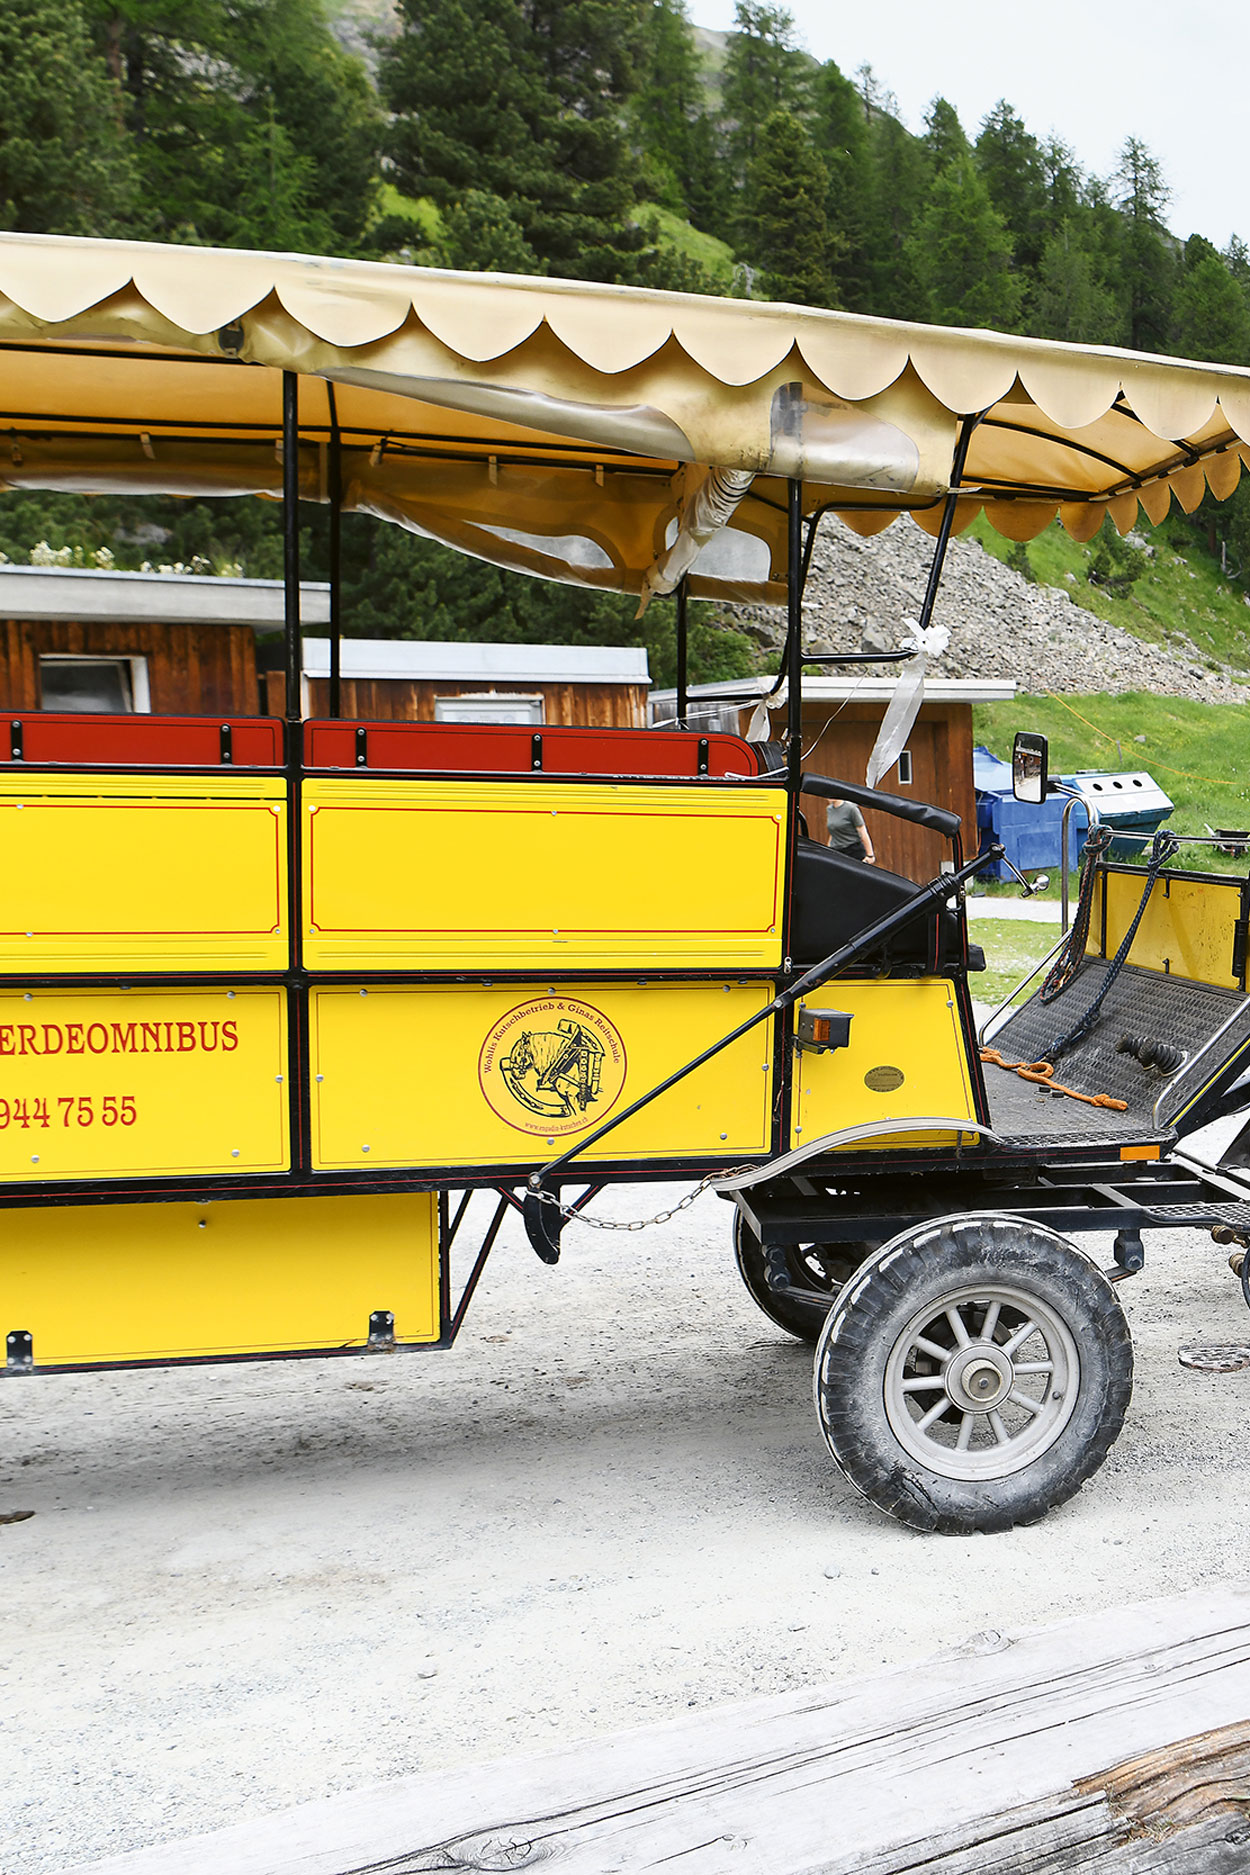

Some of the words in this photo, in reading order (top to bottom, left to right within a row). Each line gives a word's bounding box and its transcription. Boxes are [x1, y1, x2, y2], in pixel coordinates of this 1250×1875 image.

[0, 1020, 239, 1056] ERDEOMNIBUS
[484, 1042, 498, 1074] Wohlis
[493, 1002, 555, 1041] Kutschbetrieb
[557, 1002, 565, 1010] &
[567, 1003, 595, 1021] Ginas
[594, 1017, 621, 1064] Reitschule
[0, 1097, 50, 1130] 944
[57, 1096, 94, 1128] 75
[101, 1095, 137, 1127] 55
